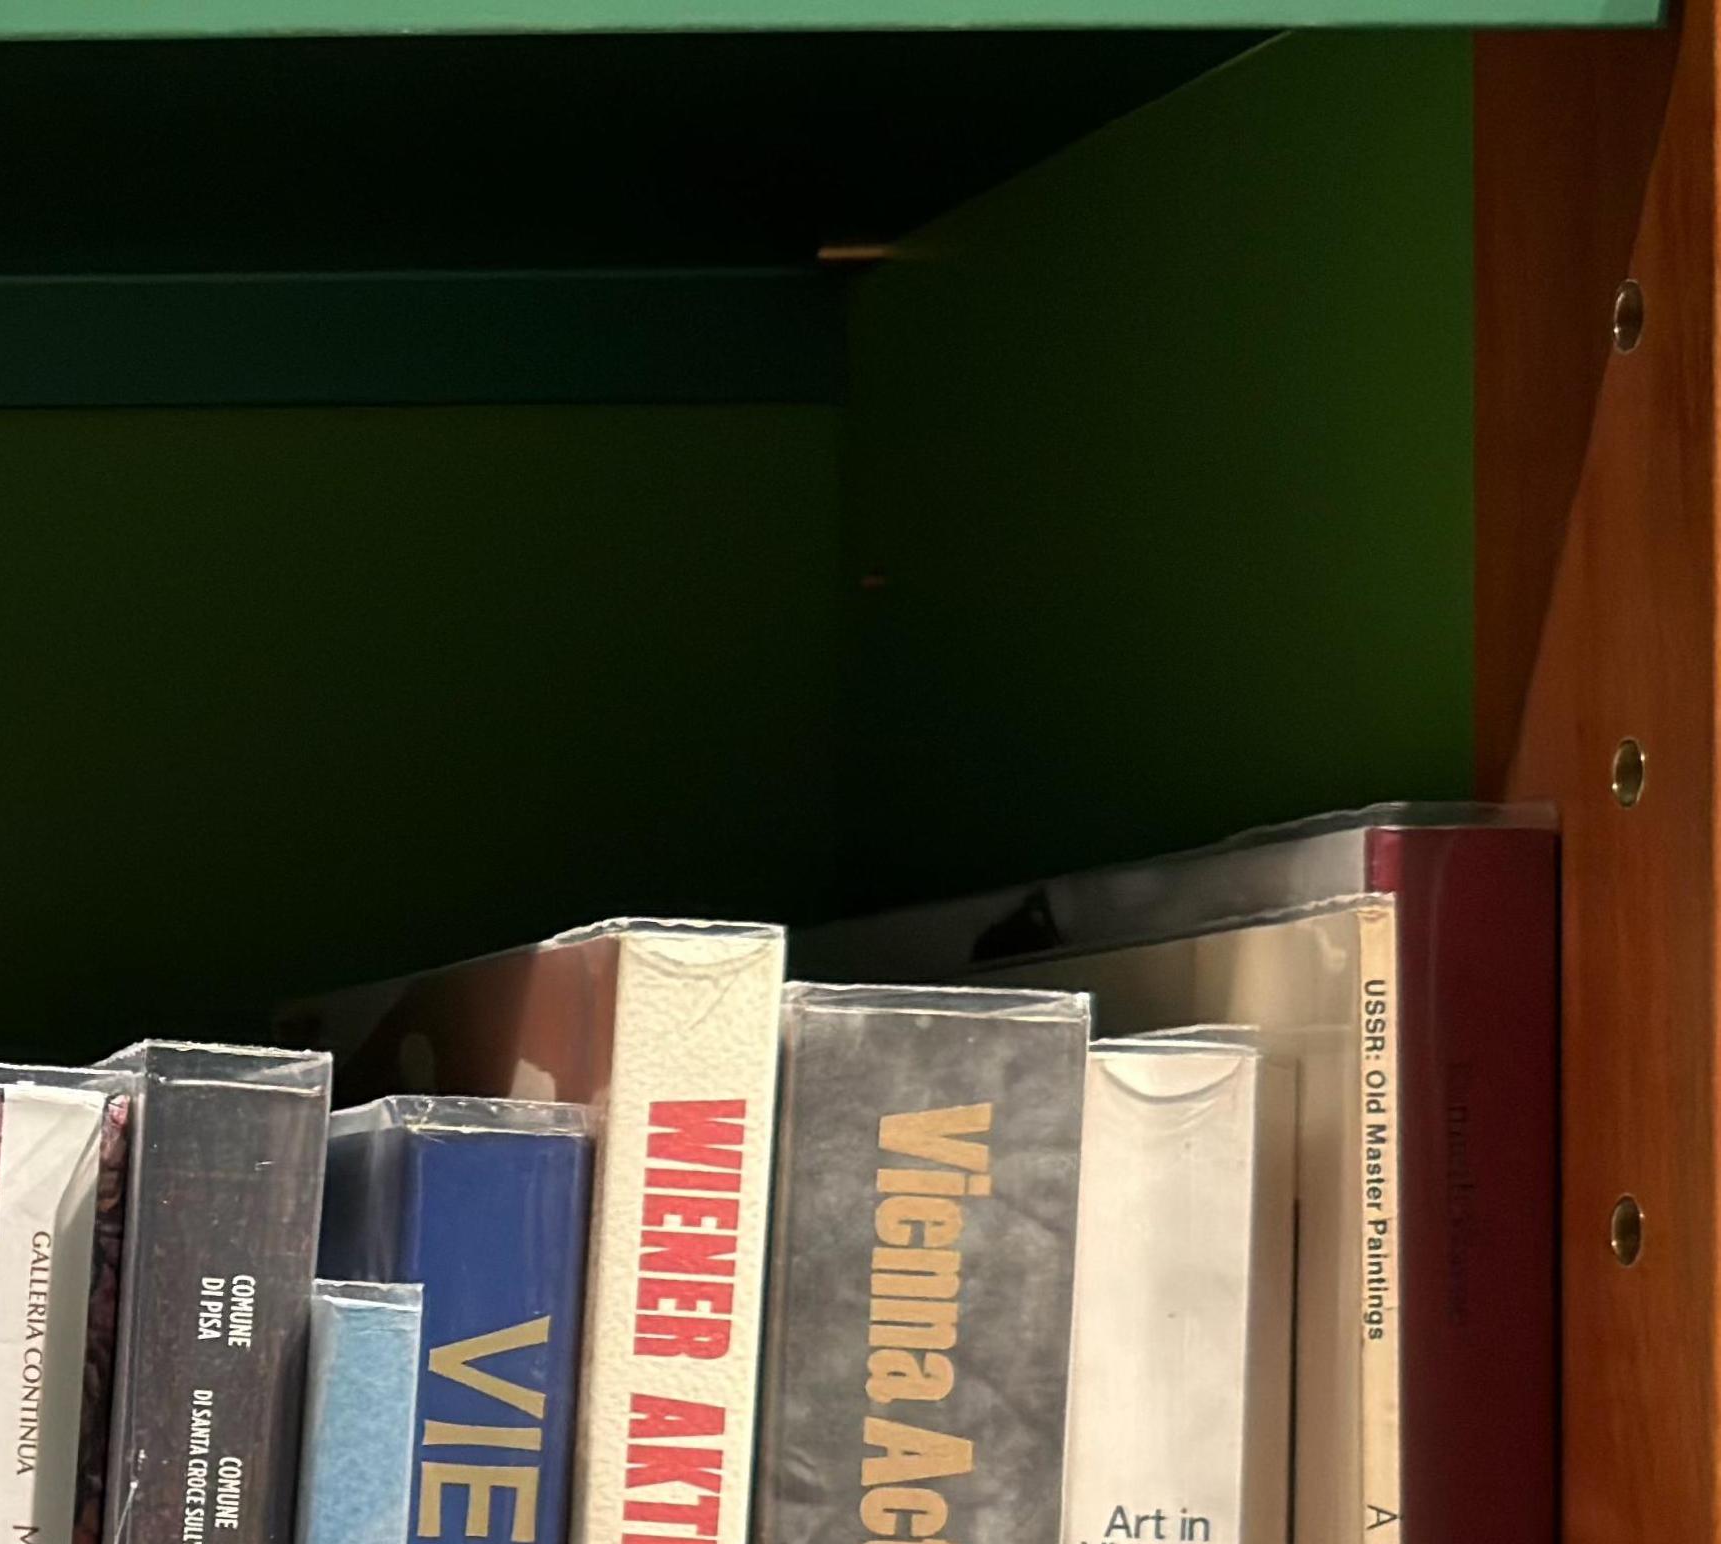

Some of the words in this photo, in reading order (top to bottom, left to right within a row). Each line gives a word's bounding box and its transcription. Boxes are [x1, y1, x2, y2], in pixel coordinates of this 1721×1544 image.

[1365, 981, 1388, 1061] USSR:
[1367, 1072, 1386, 1114] Old
[1368, 1126, 1388, 1211] Master
[632, 1099, 747, 1361] WIENER
[867, 1102, 993, 1404] Vienna
[203, 1278, 227, 1299] DI
[230, 1275, 257, 1348] COMUNE
[1364, 1220, 1389, 1340] Paintings
[199, 1301, 226, 1342] PISA
[1106, 1507, 1167, 1540] Art
[1182, 1509, 1211, 1542] in
